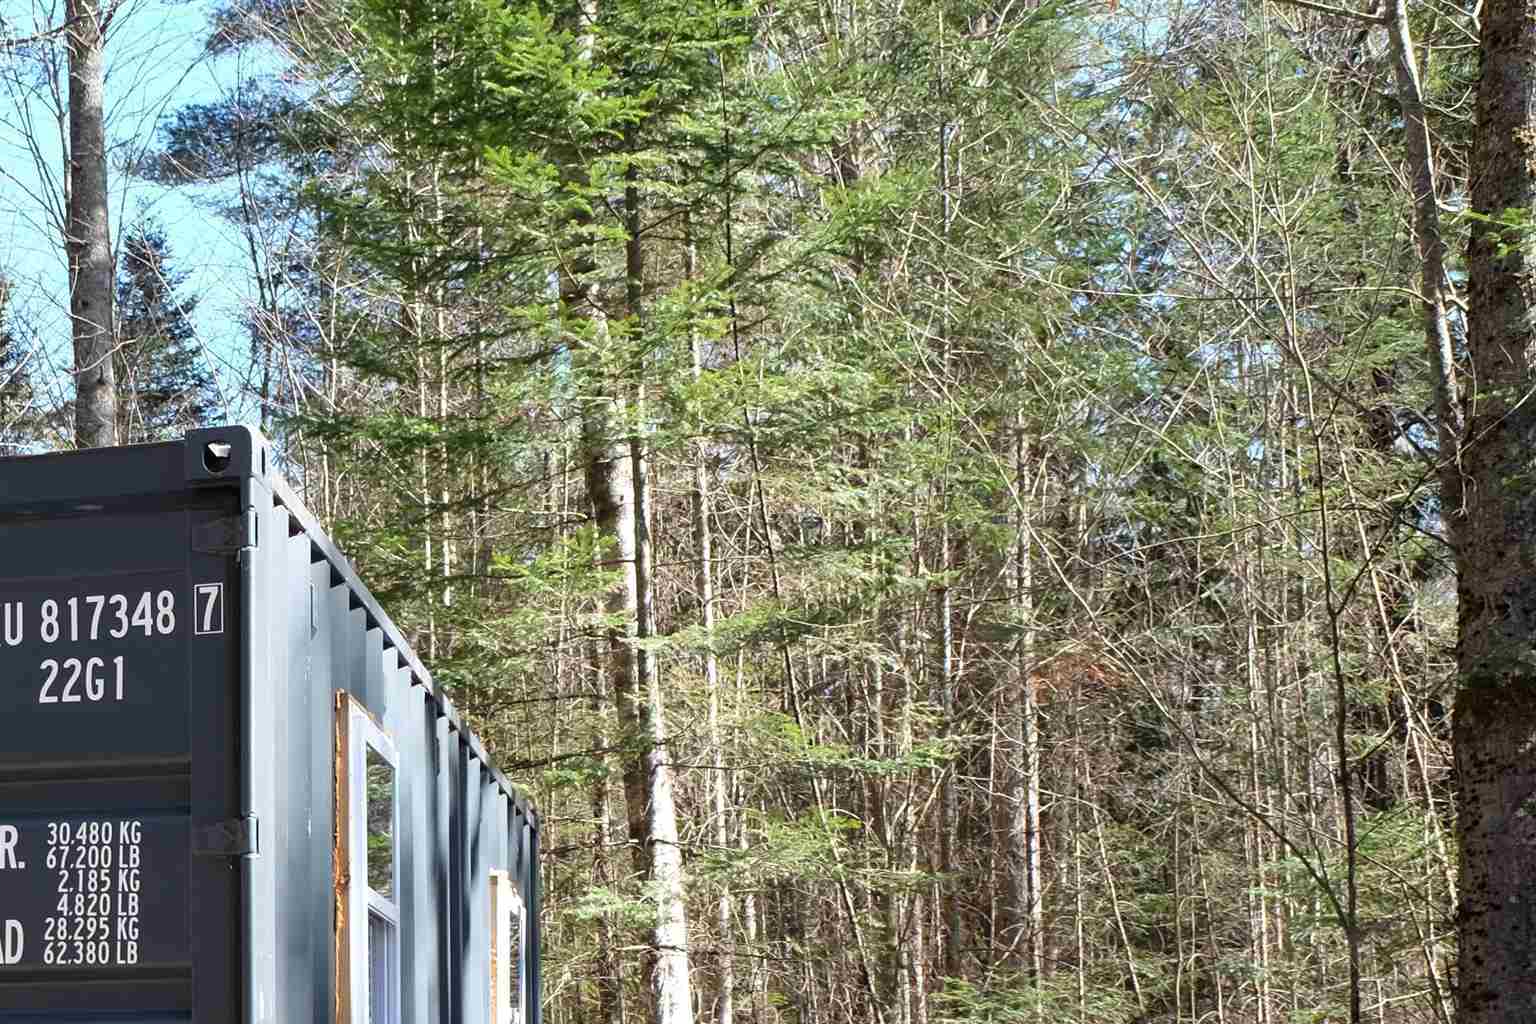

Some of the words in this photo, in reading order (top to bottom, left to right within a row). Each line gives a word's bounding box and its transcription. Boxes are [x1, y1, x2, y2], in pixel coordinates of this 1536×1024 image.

[40, 590, 176, 643] 817348
[198, 586, 219, 632] 7
[38, 655, 124, 704] 22G1
[119, 820, 142, 844] KG
[46, 845, 112, 869] 67,200
[118, 845, 140, 868] LB
[57, 869, 111, 893] 2,185
[117, 869, 141, 892] KG
[117, 893, 139, 916] LB
[44, 917, 110, 940] 28,295
[116, 917, 139, 940] KG
[43, 940, 110, 965] 62,380
[116, 940, 138, 964] LB
